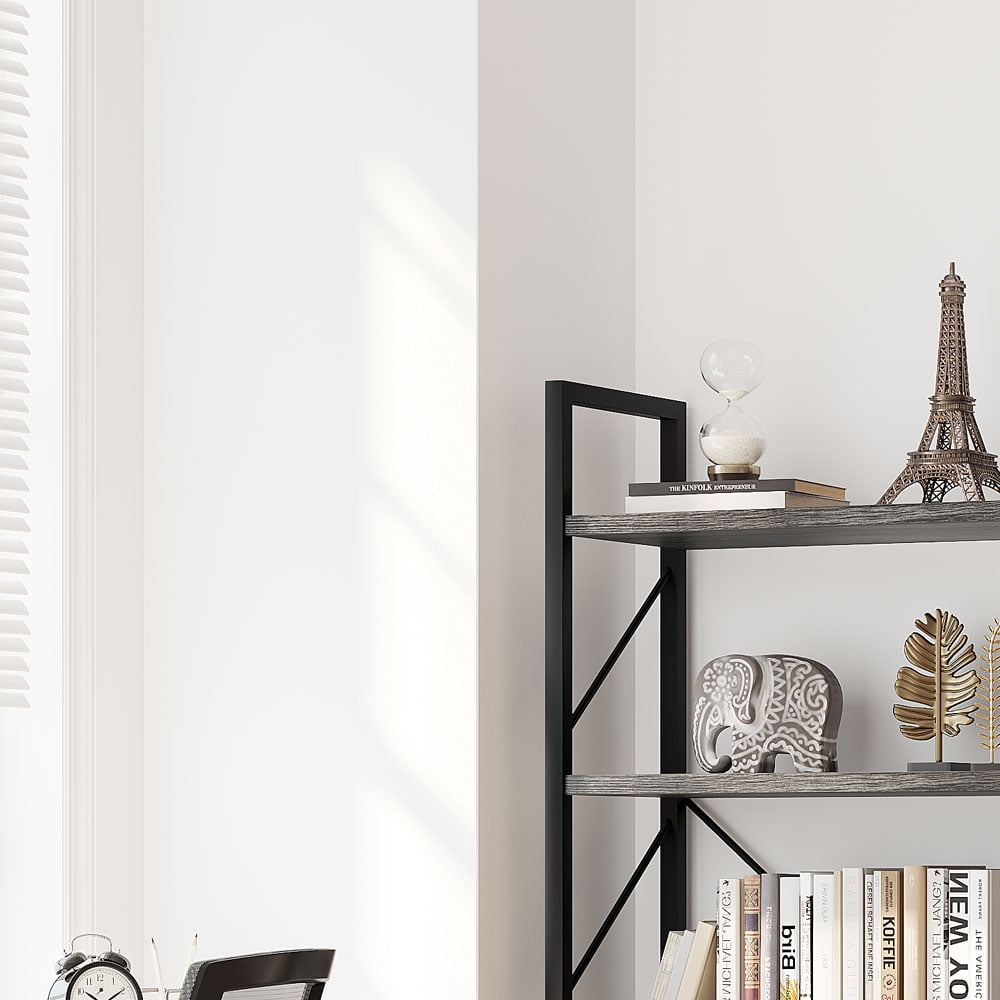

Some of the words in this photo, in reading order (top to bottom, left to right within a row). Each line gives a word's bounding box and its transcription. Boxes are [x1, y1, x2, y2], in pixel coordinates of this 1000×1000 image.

[681, 484, 712, 492] KINFOLK
[932, 882, 942, 927] JANG?
[883, 917, 895, 970] KOFFIE
[932, 929, 942, 992] MICHAEL
[86, 977, 92, 986] 11
[96, 974, 104, 982] 12
